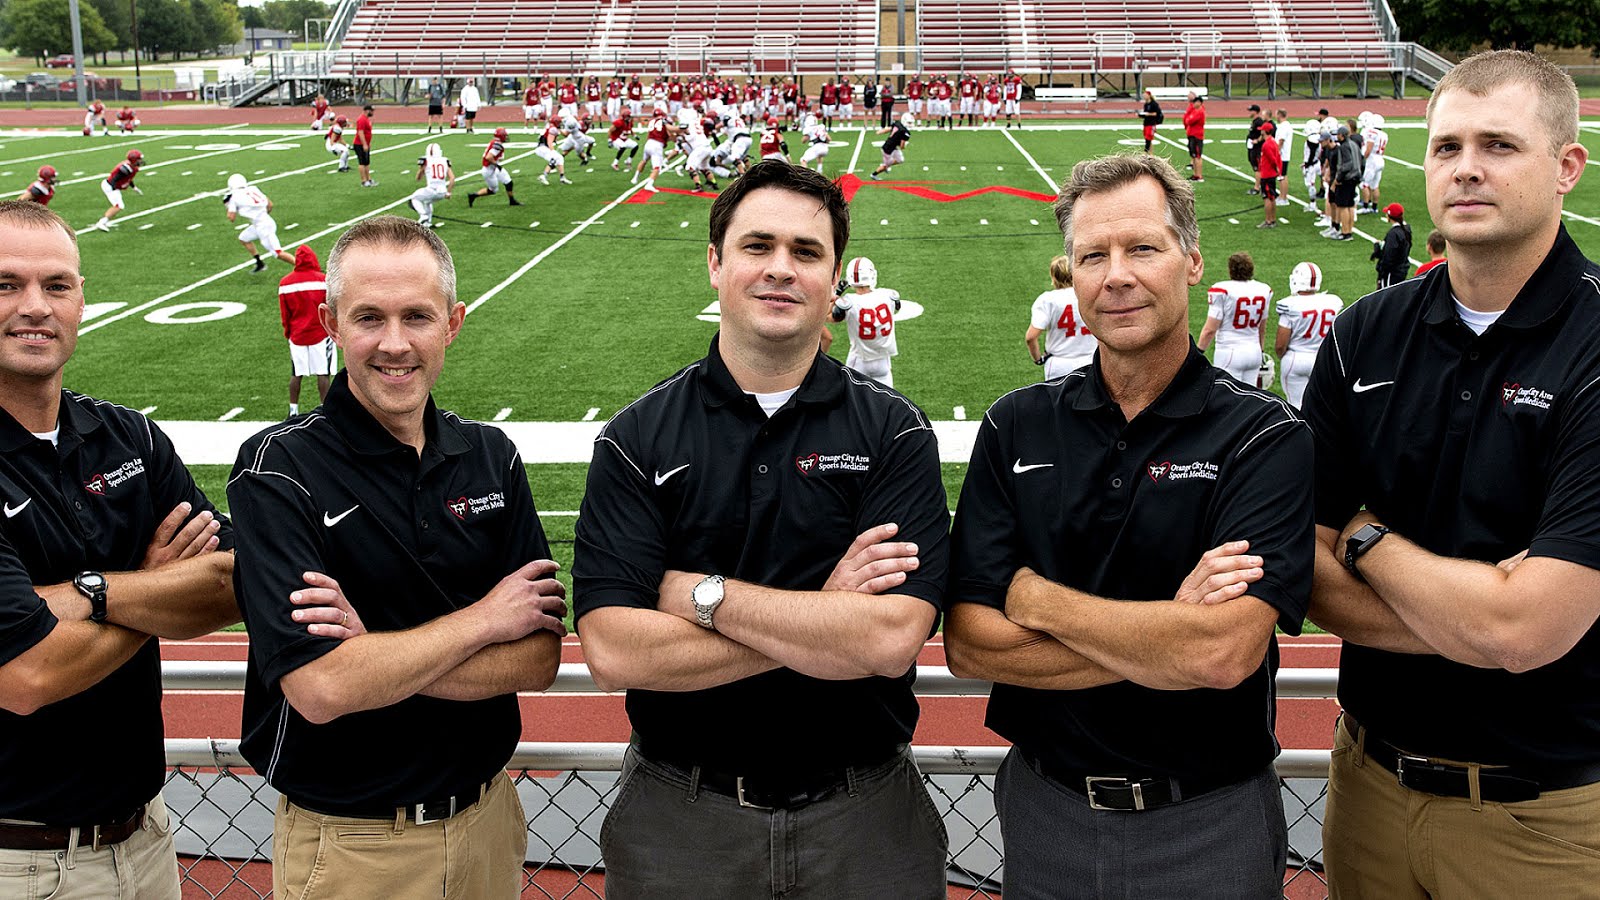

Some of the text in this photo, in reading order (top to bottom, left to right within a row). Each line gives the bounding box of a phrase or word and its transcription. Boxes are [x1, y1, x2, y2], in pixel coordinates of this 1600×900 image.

[432, 163, 445, 180] 10
[1232, 296, 1266, 330] 63
[858, 303, 893, 340] 89
[1302, 309, 1336, 338] 76
[818, 454, 870, 464] Orange City Area
[818, 462, 870, 472] Sports Medicine
[1170, 461, 1218, 472] Orange City Area
[103, 468, 124, 481] Orange
[1168, 470, 1218, 480] Sports Medicine
[108, 475, 128, 488] Sports
[468, 496, 489, 506] Orange
[488, 492, 500, 500] City
[470, 504, 490, 514] Sports
